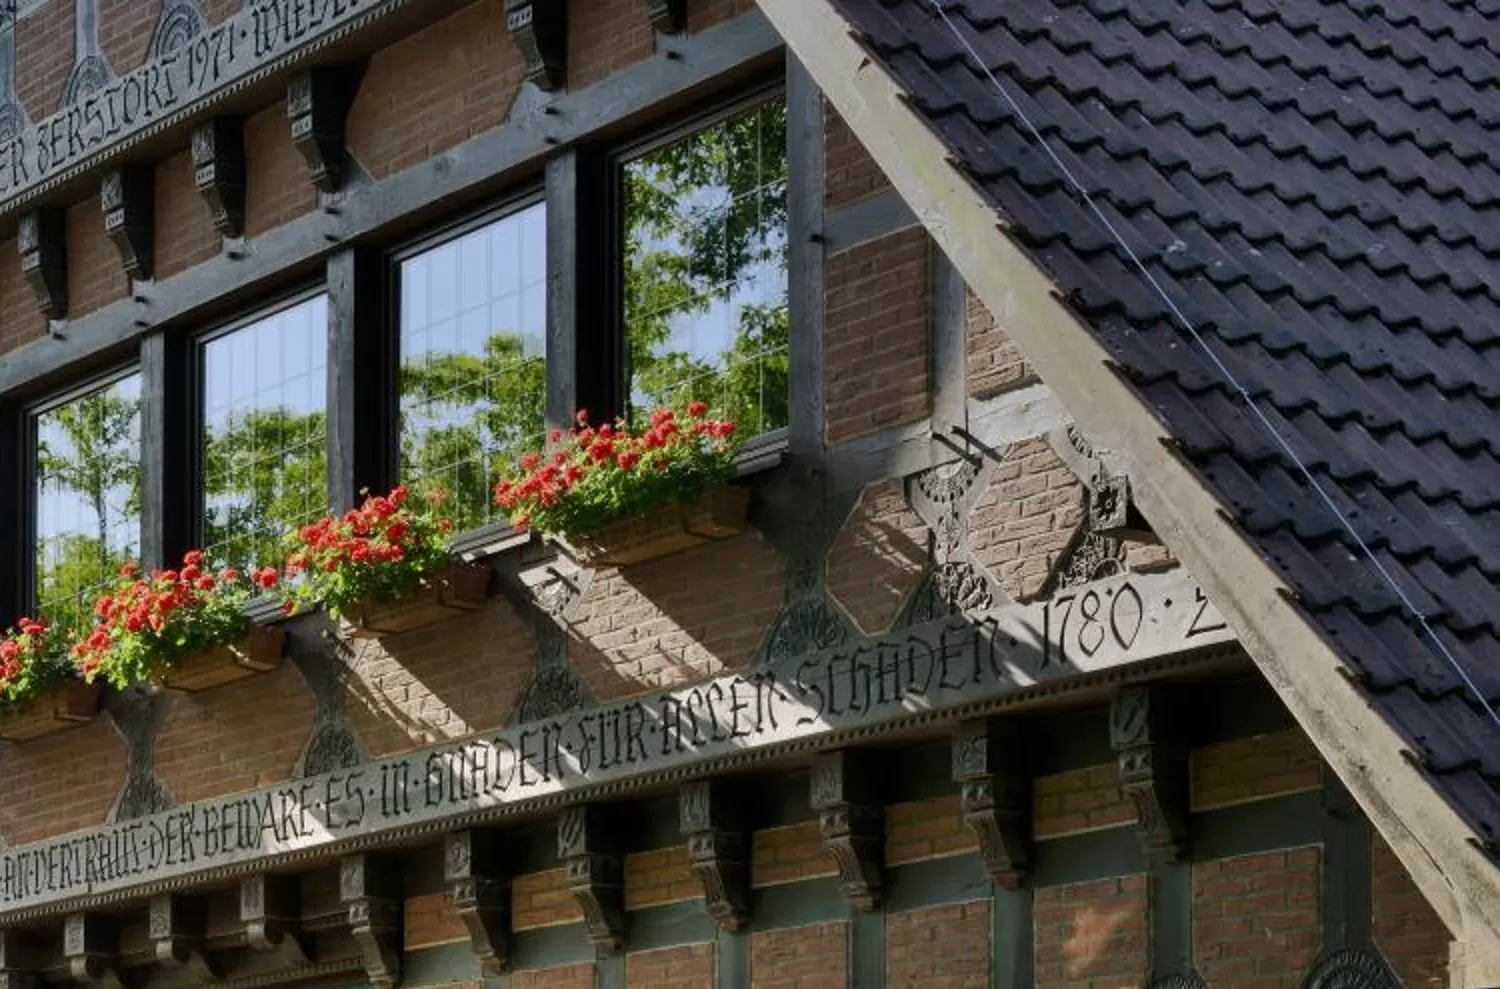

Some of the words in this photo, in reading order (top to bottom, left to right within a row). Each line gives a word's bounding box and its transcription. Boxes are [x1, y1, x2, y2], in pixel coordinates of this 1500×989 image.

[187, 21, 236, 91] 1971
[148, 808, 196, 869] DER
[324, 773, 366, 828] ES
[380, 761, 411, 816] IN
[424, 722, 563, 811] GNADEN
[578, 701, 648, 773] FÜR
[660, 671, 778, 755] ALLEN
[795, 616, 1003, 726] SCHADEN
[1040, 581, 1143, 669] 1780
